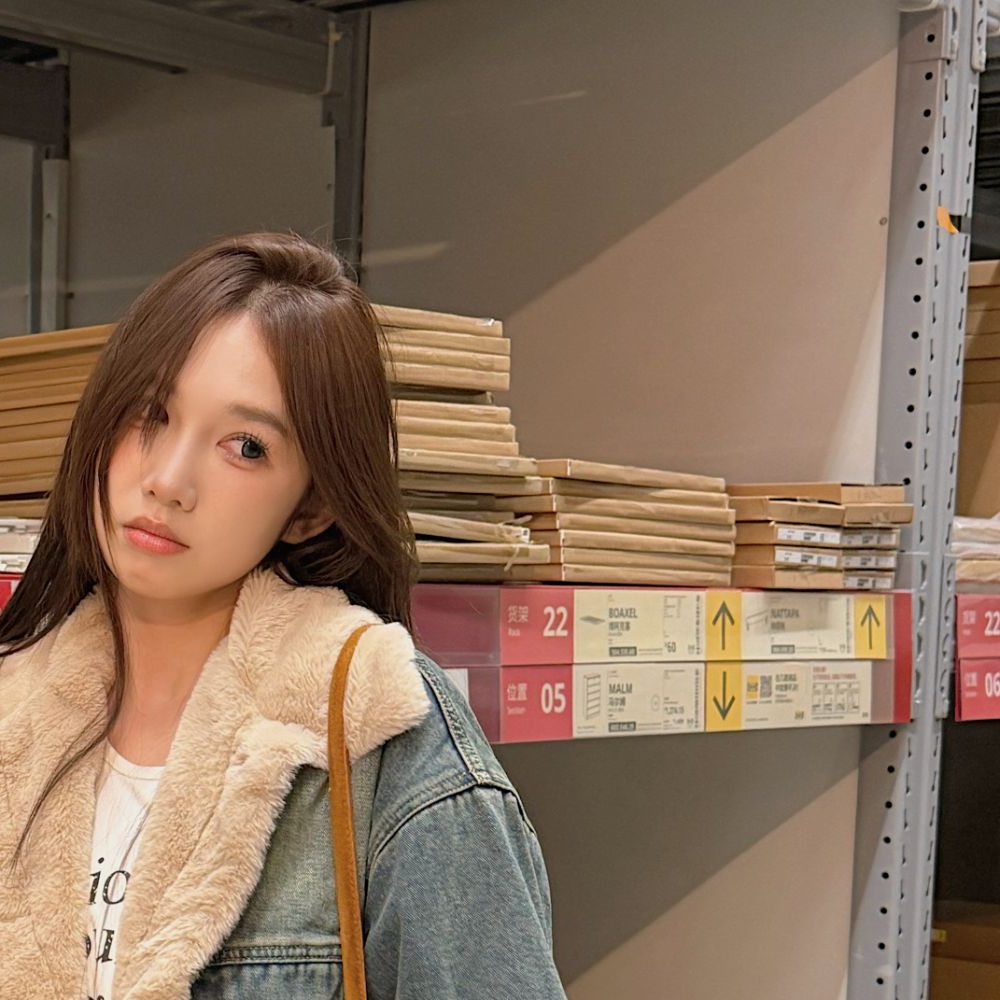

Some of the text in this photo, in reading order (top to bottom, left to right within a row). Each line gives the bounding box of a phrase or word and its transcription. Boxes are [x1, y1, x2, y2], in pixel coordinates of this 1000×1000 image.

[508, 605, 568, 637] 货架 22
[609, 607, 638, 619] BOAXEL
[984, 610, 1000, 637] 22
[507, 682, 567, 714] 位置 05
[608, 683, 634, 695] MALM
[984, 671, 1000, 698] 06
